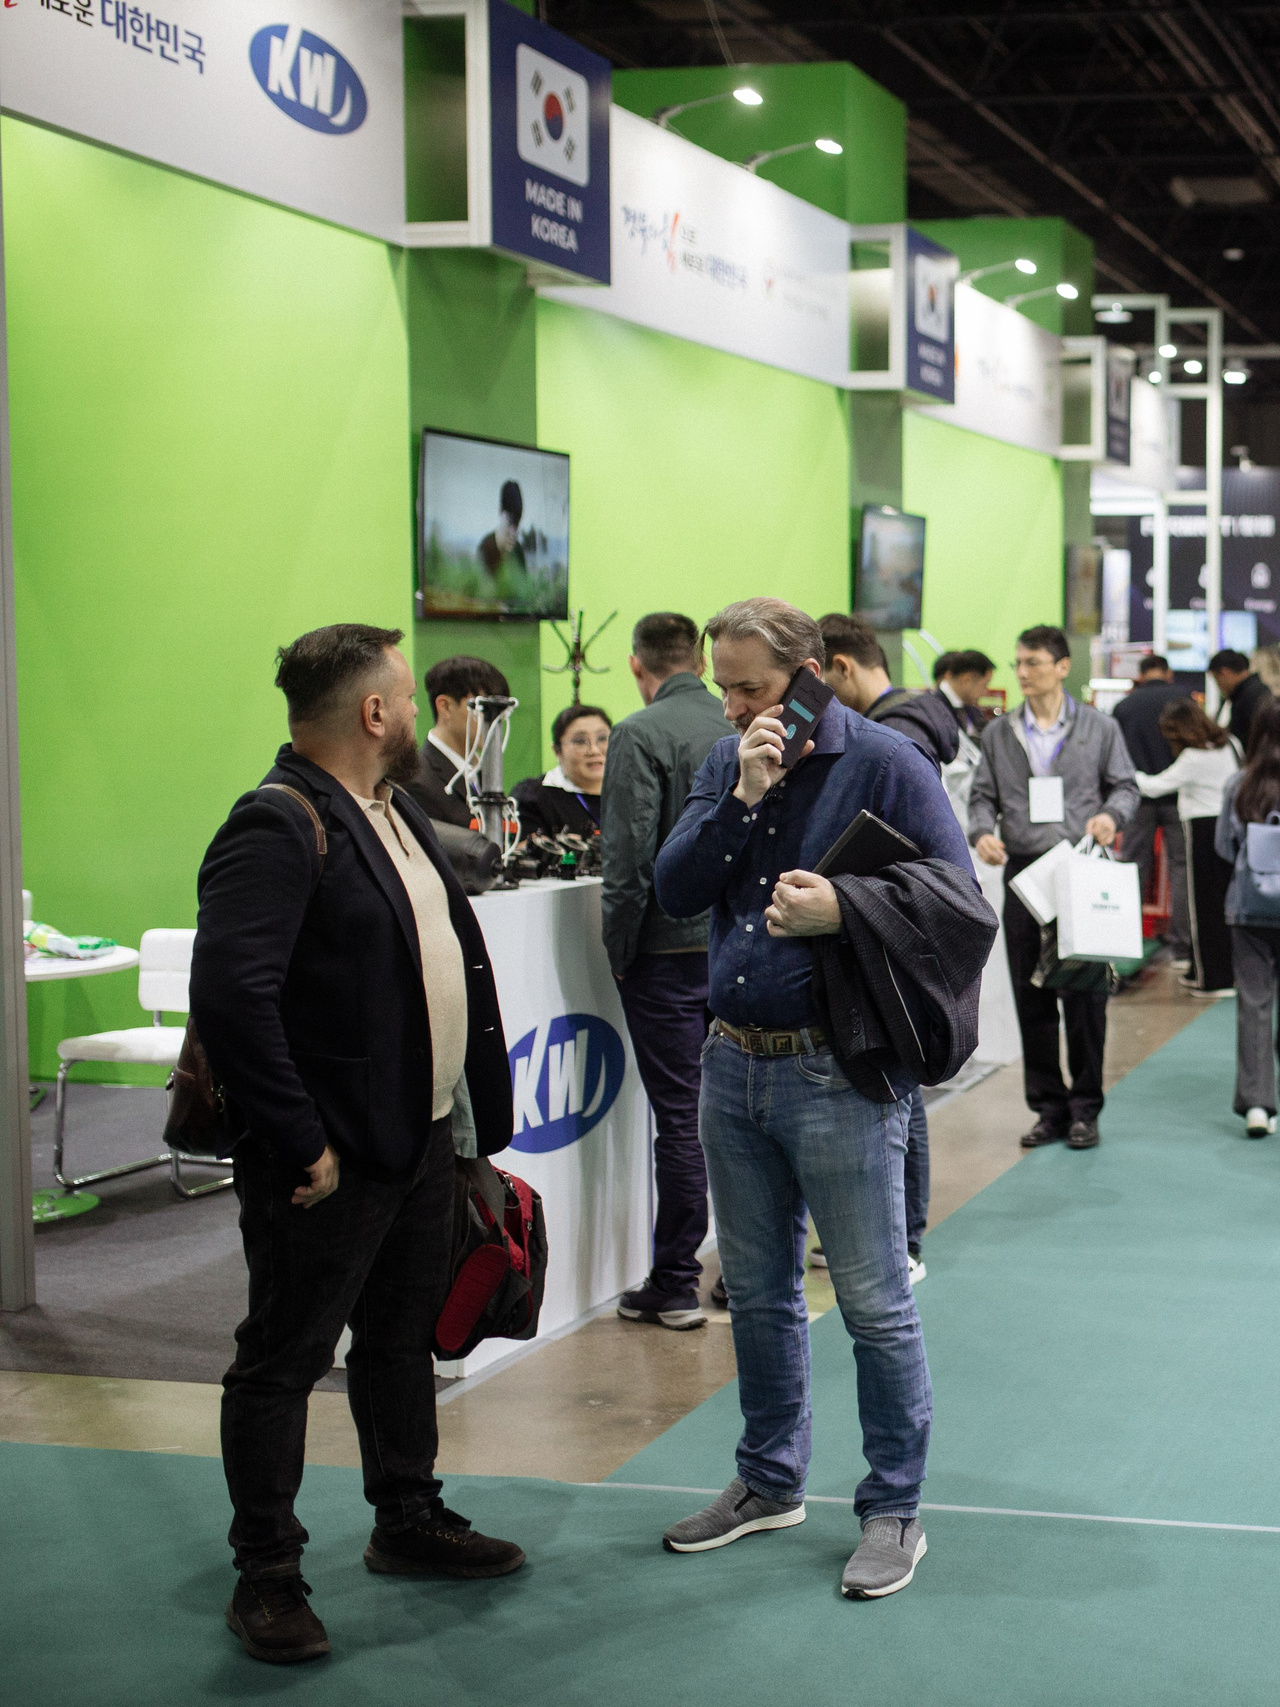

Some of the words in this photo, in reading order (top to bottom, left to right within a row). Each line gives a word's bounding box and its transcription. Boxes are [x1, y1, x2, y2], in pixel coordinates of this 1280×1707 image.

[100, 0, 206, 74] 대한민국
[525, 178, 567, 217] MADE
[567, 195, 583, 223] IN
[531, 213, 579, 254] KOREA
